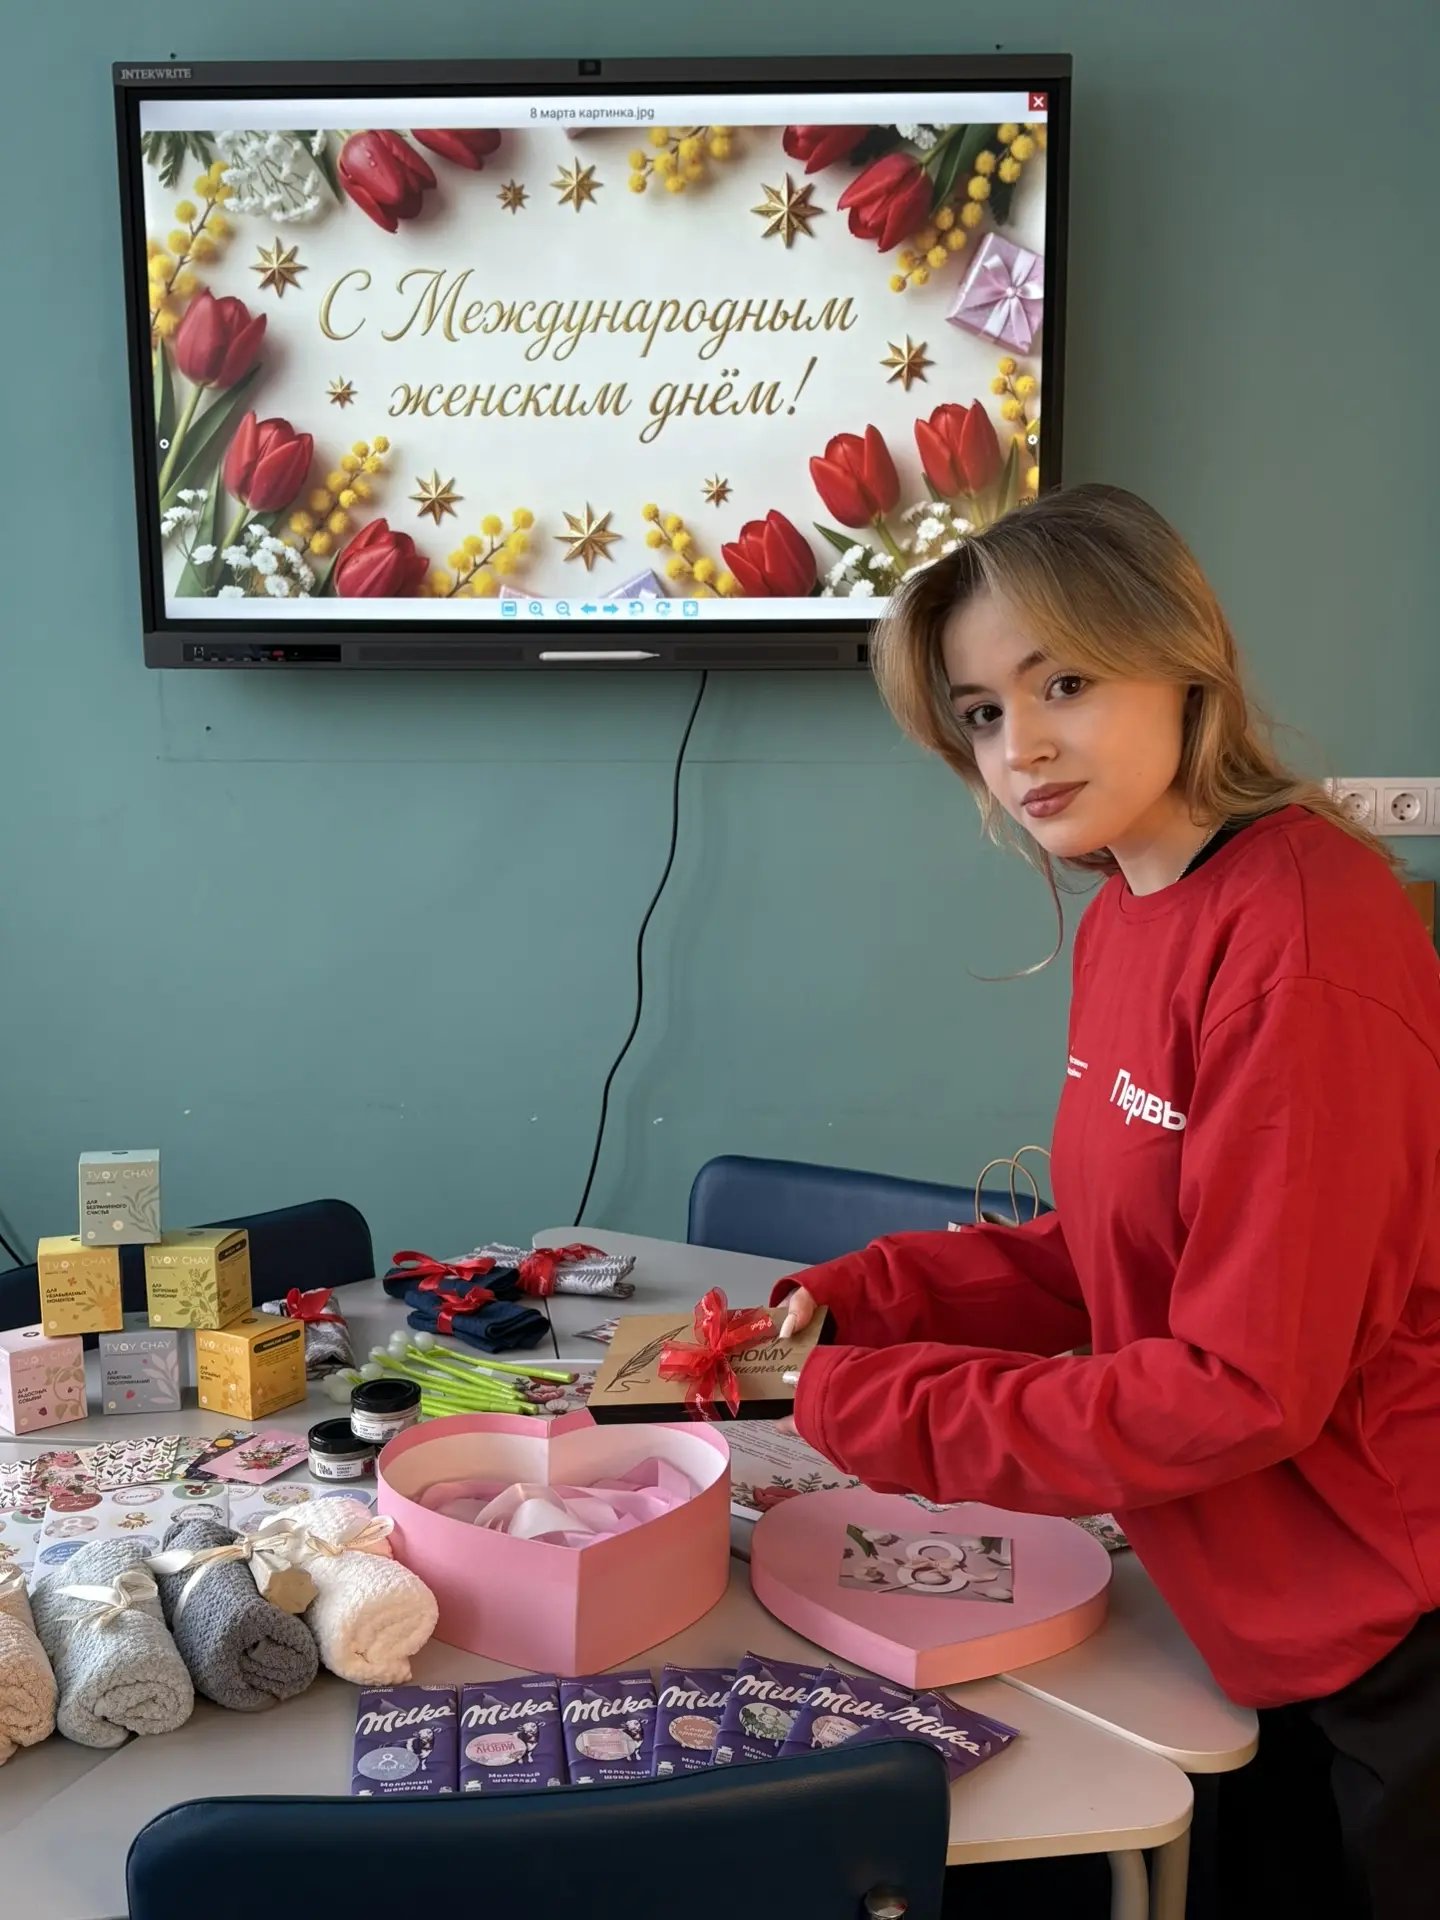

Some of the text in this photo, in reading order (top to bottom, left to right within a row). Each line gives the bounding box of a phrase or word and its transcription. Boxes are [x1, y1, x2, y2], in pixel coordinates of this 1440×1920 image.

[121, 68, 192, 79] INTERWRITE
[530, 106, 655, 120] 8 марта картинка.jpg
[318, 267, 858, 361] С Международным
[387, 356, 818, 444] женским днём!
[123, 1169, 154, 1178] CHAY
[182, 1256, 210, 1265] CHAY
[140, 1340, 172, 1350] CHAY
[461, 1699, 558, 1728] Milka
[563, 1696, 658, 1723] Milka
[807, 1687, 887, 1720] Milk
[355, 1703, 456, 1735] Milka
[888, 1707, 980, 1756] Milka
